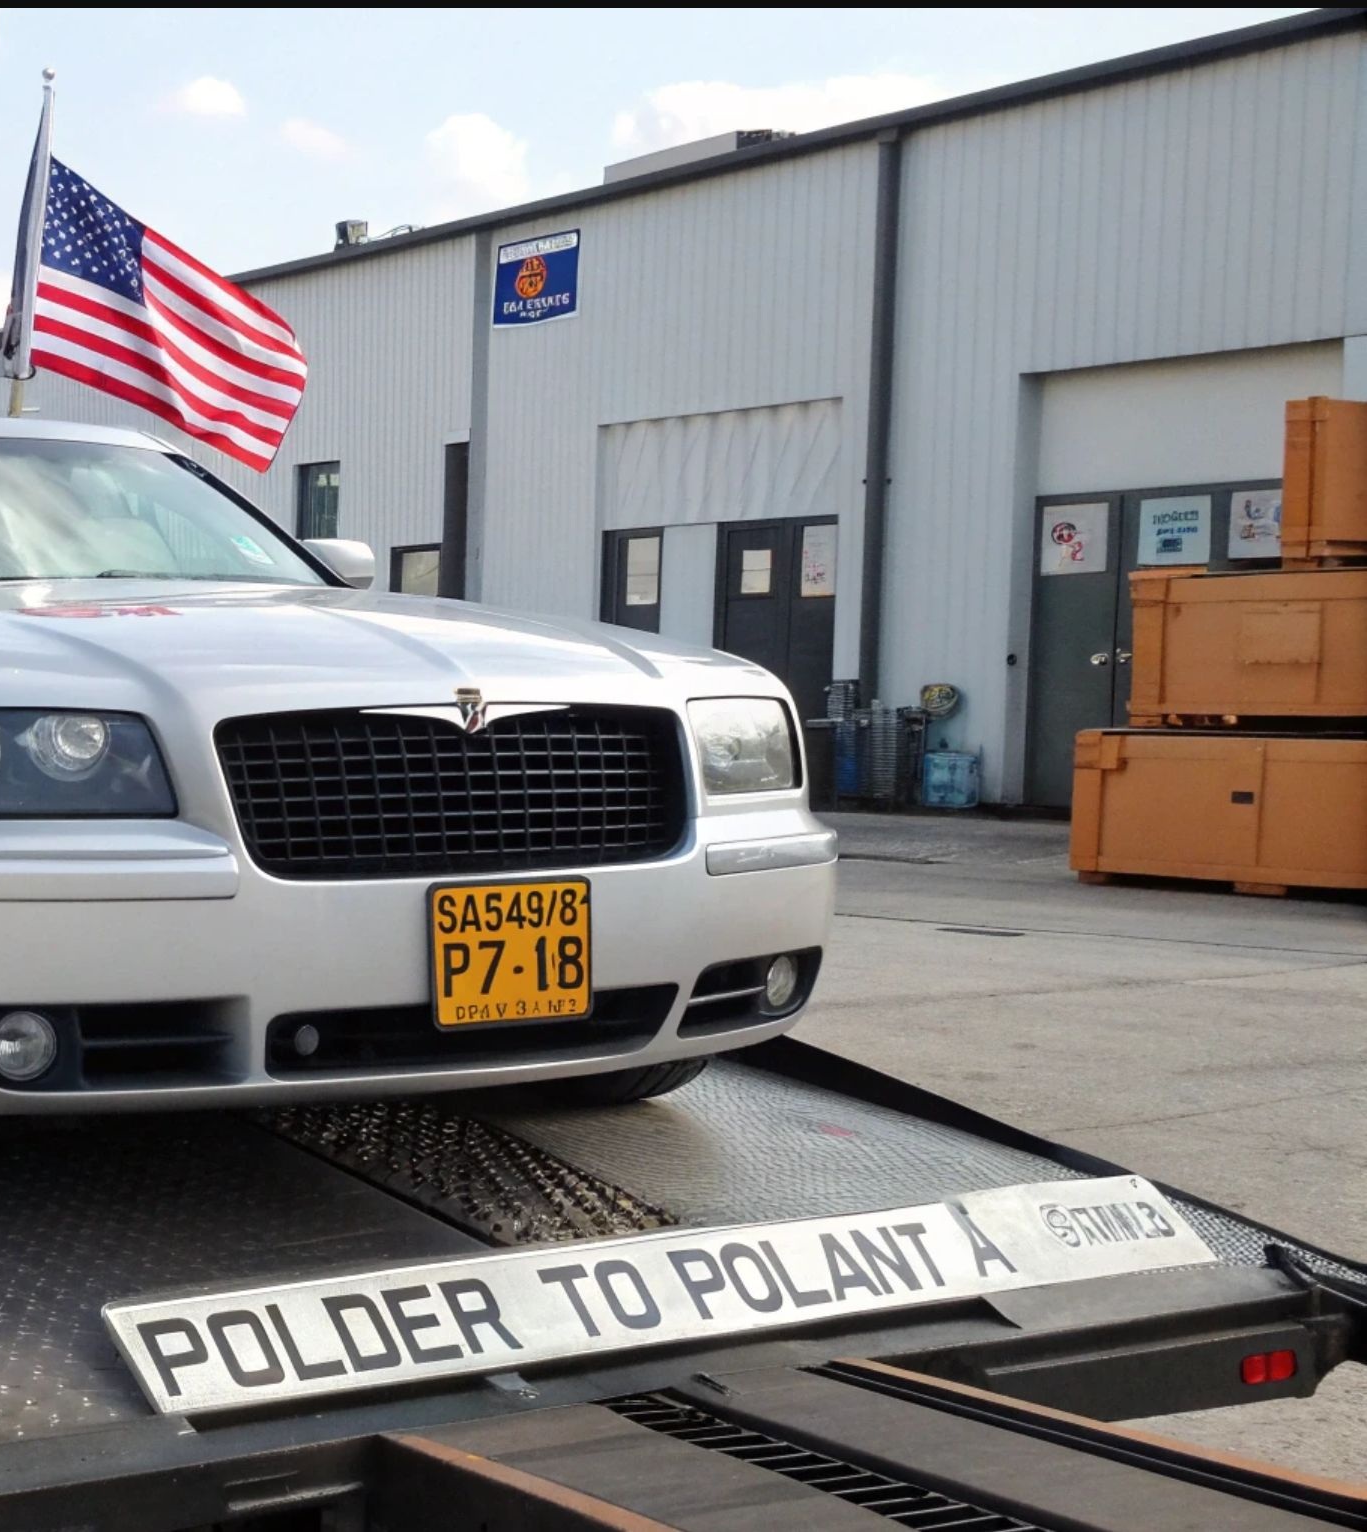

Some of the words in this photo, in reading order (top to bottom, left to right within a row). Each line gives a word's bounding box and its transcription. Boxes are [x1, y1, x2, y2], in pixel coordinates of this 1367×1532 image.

[136, 1278, 524, 1397] POLDER
[536, 1258, 662, 1337] TO
[666, 1222, 946, 1320] POLANT
